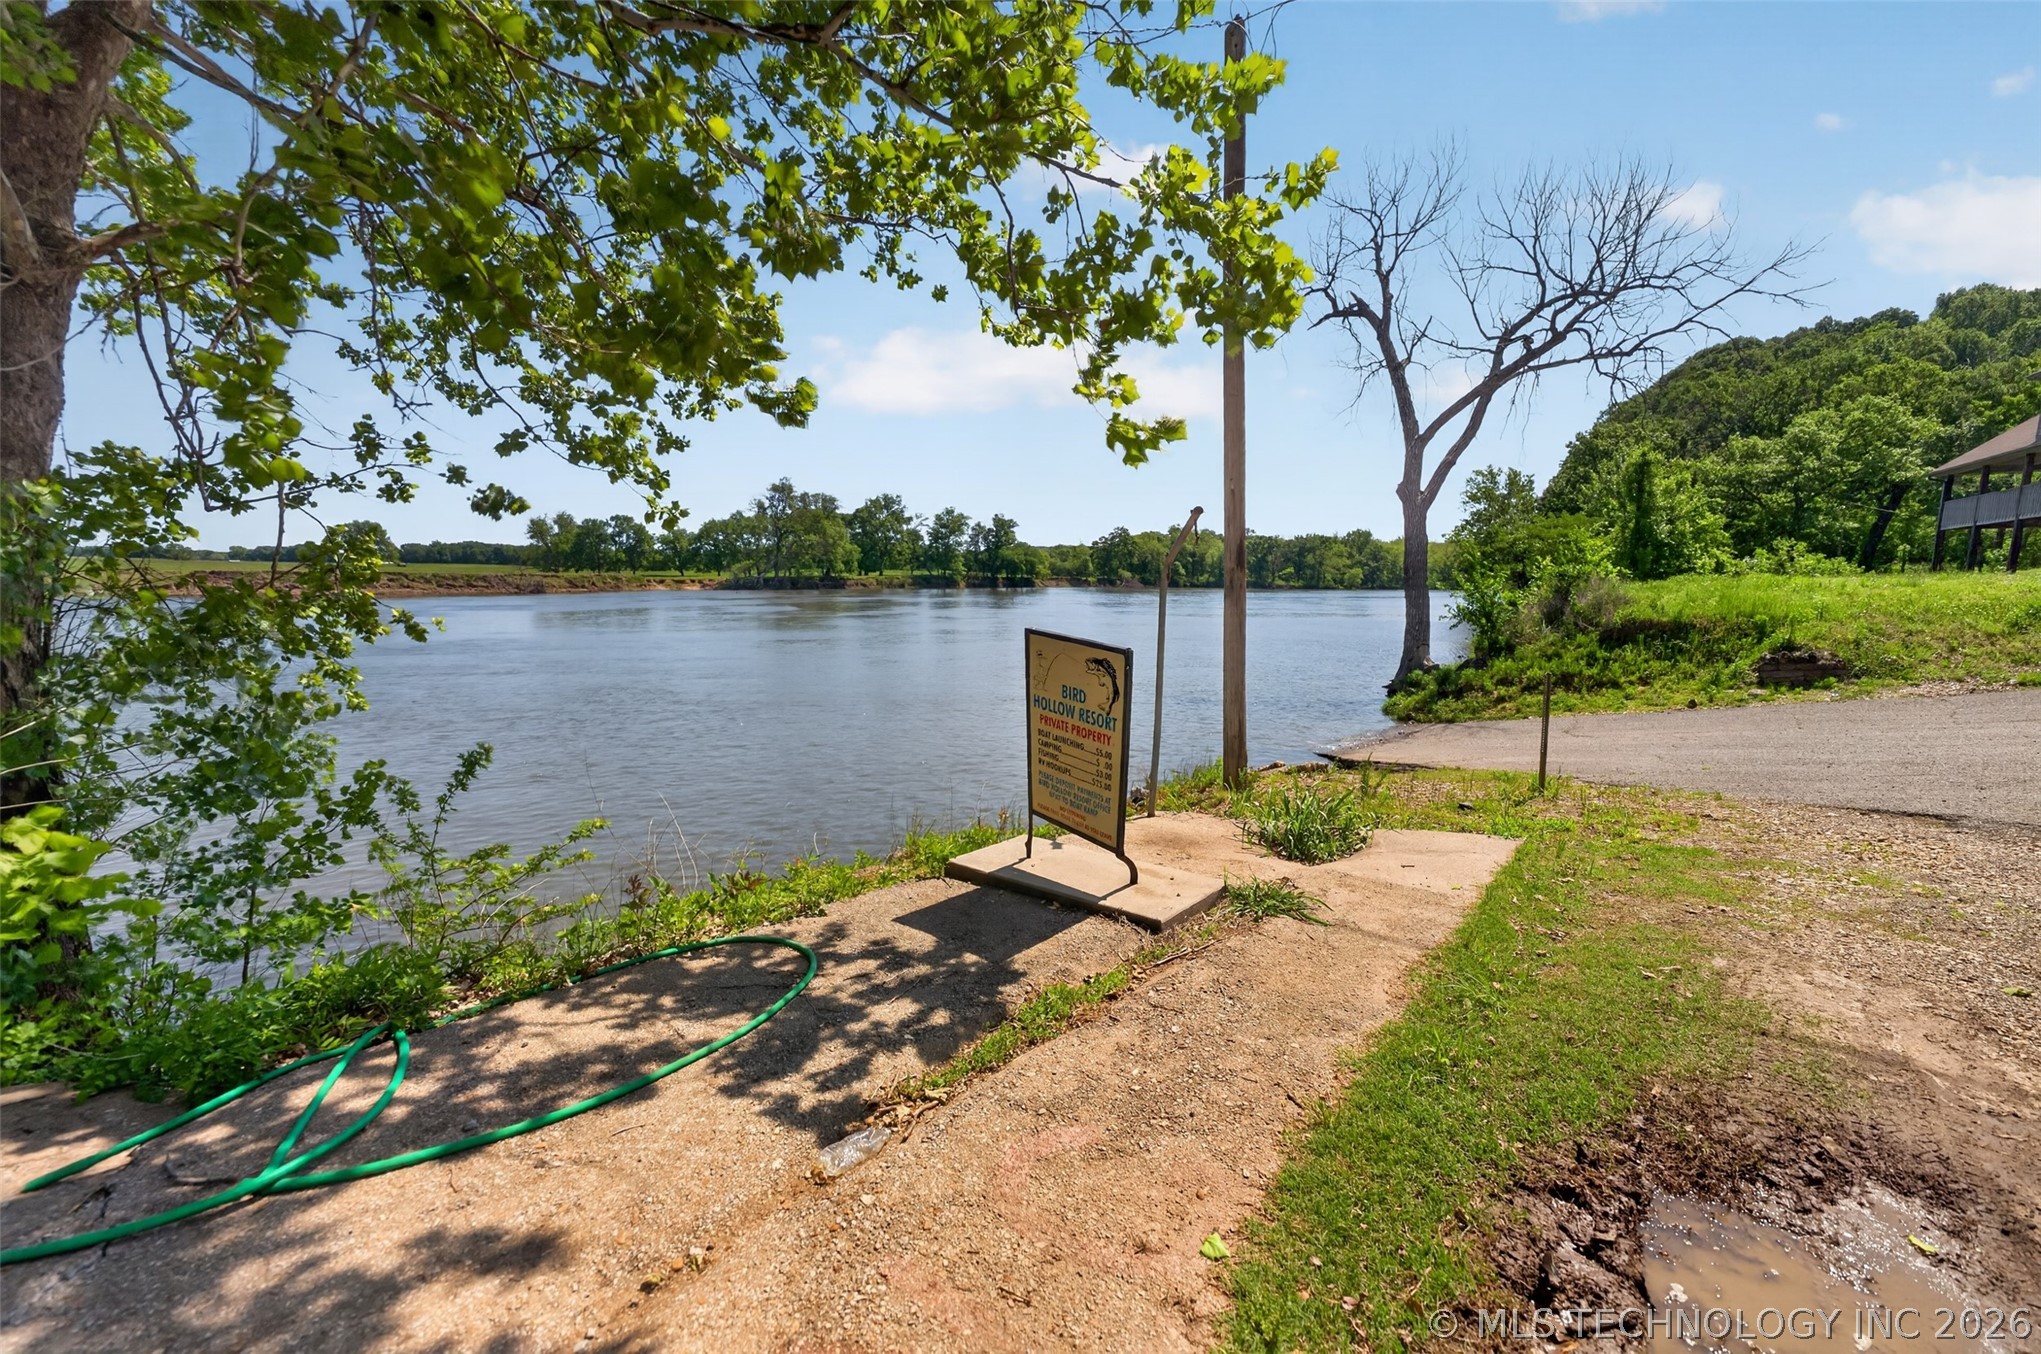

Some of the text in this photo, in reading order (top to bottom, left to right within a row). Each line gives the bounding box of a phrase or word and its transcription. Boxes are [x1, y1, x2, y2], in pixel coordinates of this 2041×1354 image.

[1062, 685, 1086, 703] BIRD
[1034, 695, 1118, 733] HOLLOW RESORT
[1038, 728, 1051, 739] BOAT
[1052, 733, 1084, 751] LAUNCHING
[1040, 714, 1112, 746] PRIVATE PROPERTY
[1038, 738, 1062, 754] CAMPING
[1038, 748, 1059, 762] FISHING
